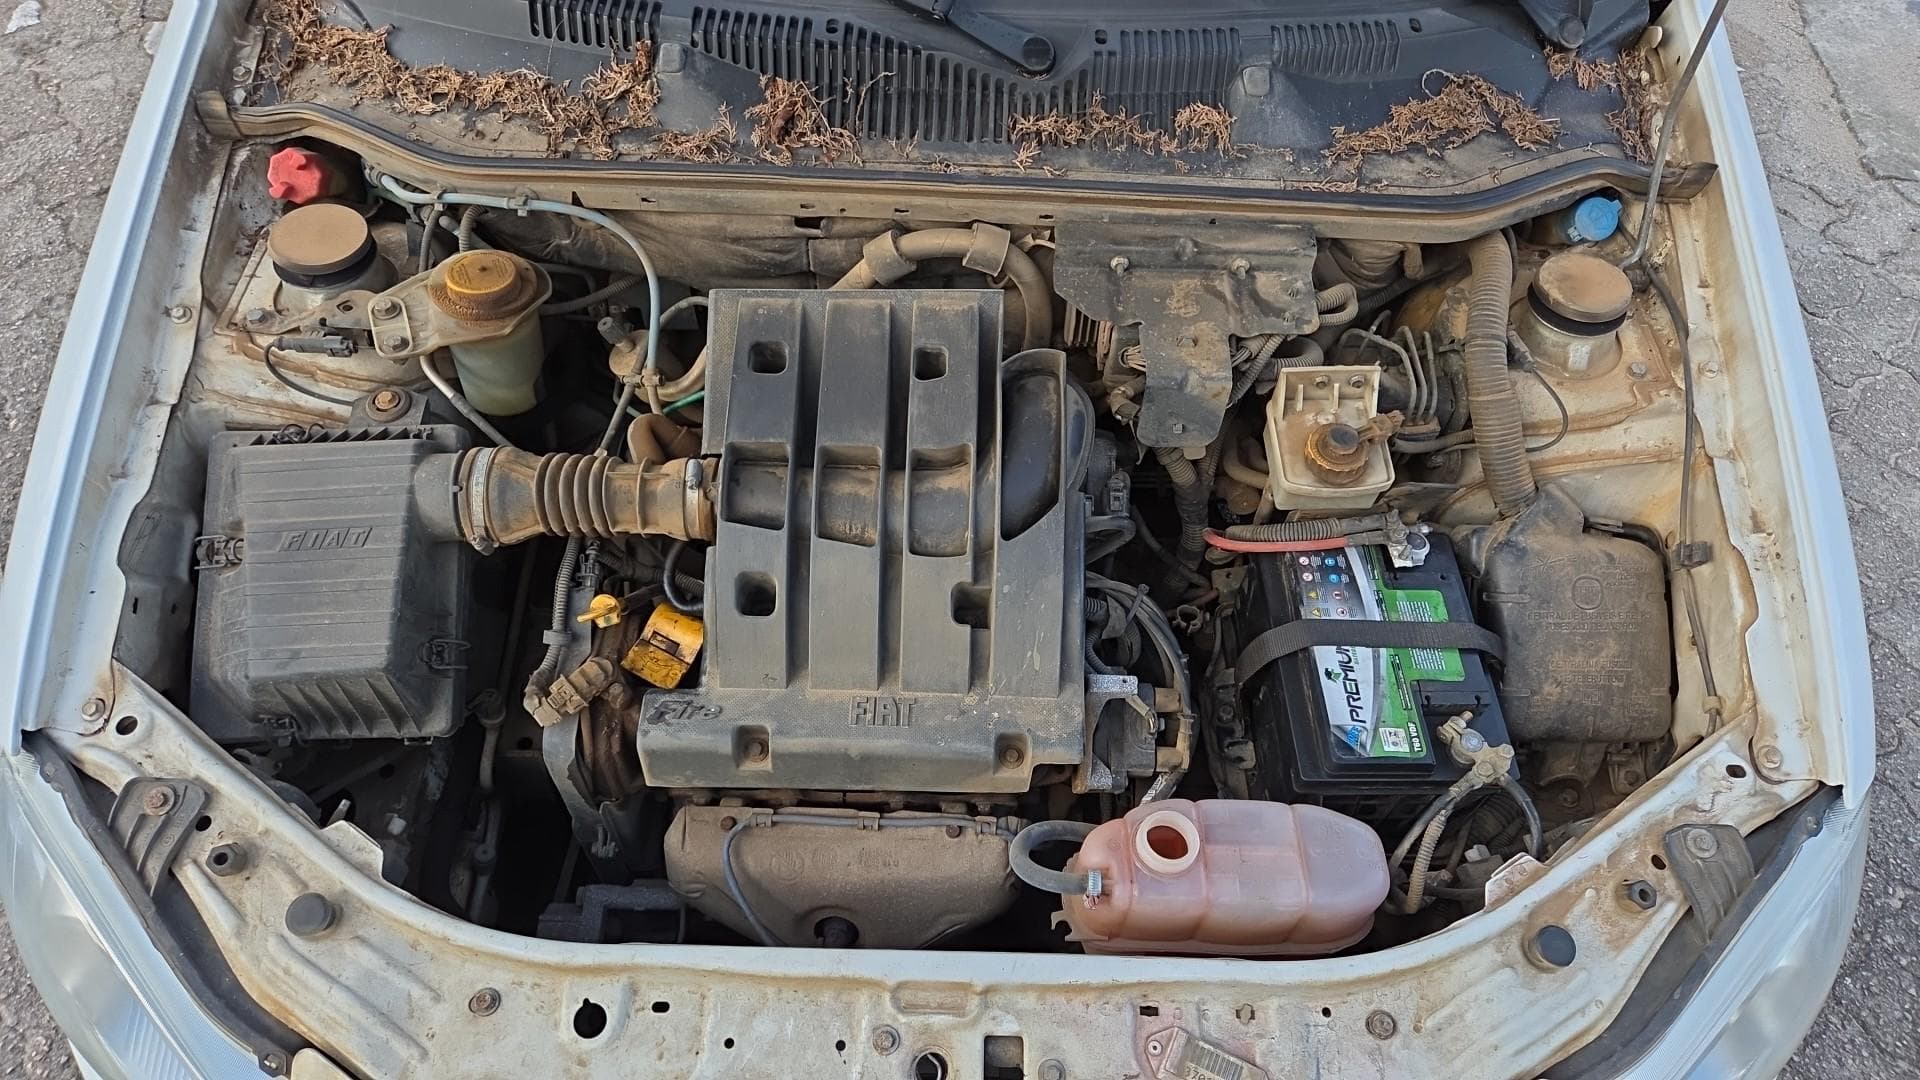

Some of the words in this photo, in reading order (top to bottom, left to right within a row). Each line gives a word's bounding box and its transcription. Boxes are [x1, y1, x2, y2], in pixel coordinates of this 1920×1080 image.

[281, 528, 370, 551] FIAT
[647, 699, 723, 726] Fire
[850, 696, 916, 728] FIAT
